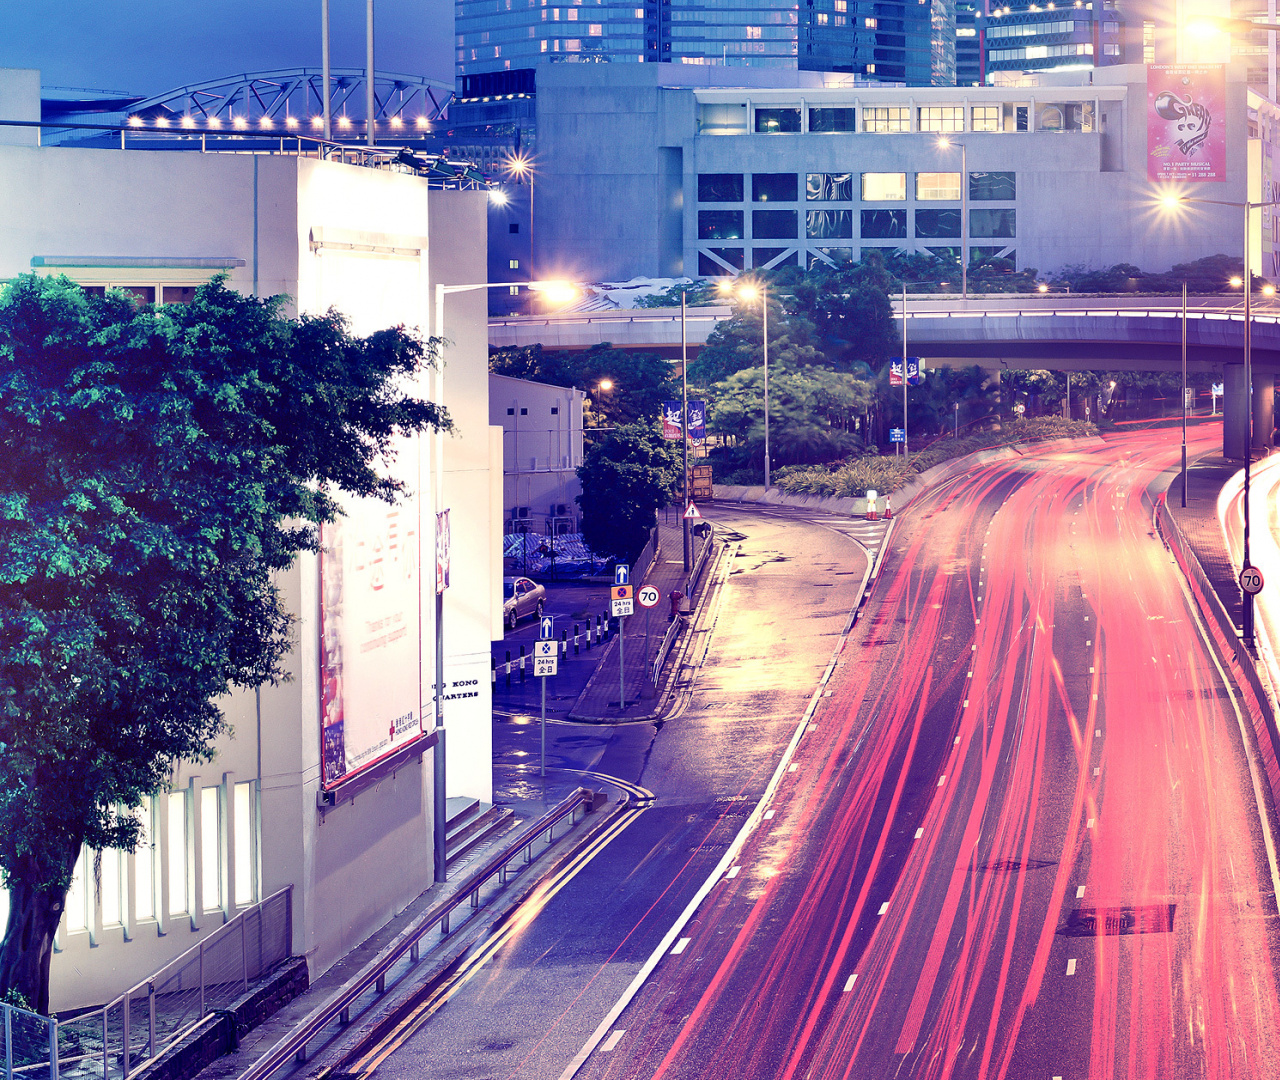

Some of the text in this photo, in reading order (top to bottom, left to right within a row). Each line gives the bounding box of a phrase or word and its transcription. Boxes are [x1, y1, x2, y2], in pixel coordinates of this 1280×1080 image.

[1244, 575, 1260, 586] 70
[642, 592, 656, 602] 70
[616, 606, 630, 615] 全日
[538, 666, 553, 674] 全日
[452, 680, 478, 688] KONG
